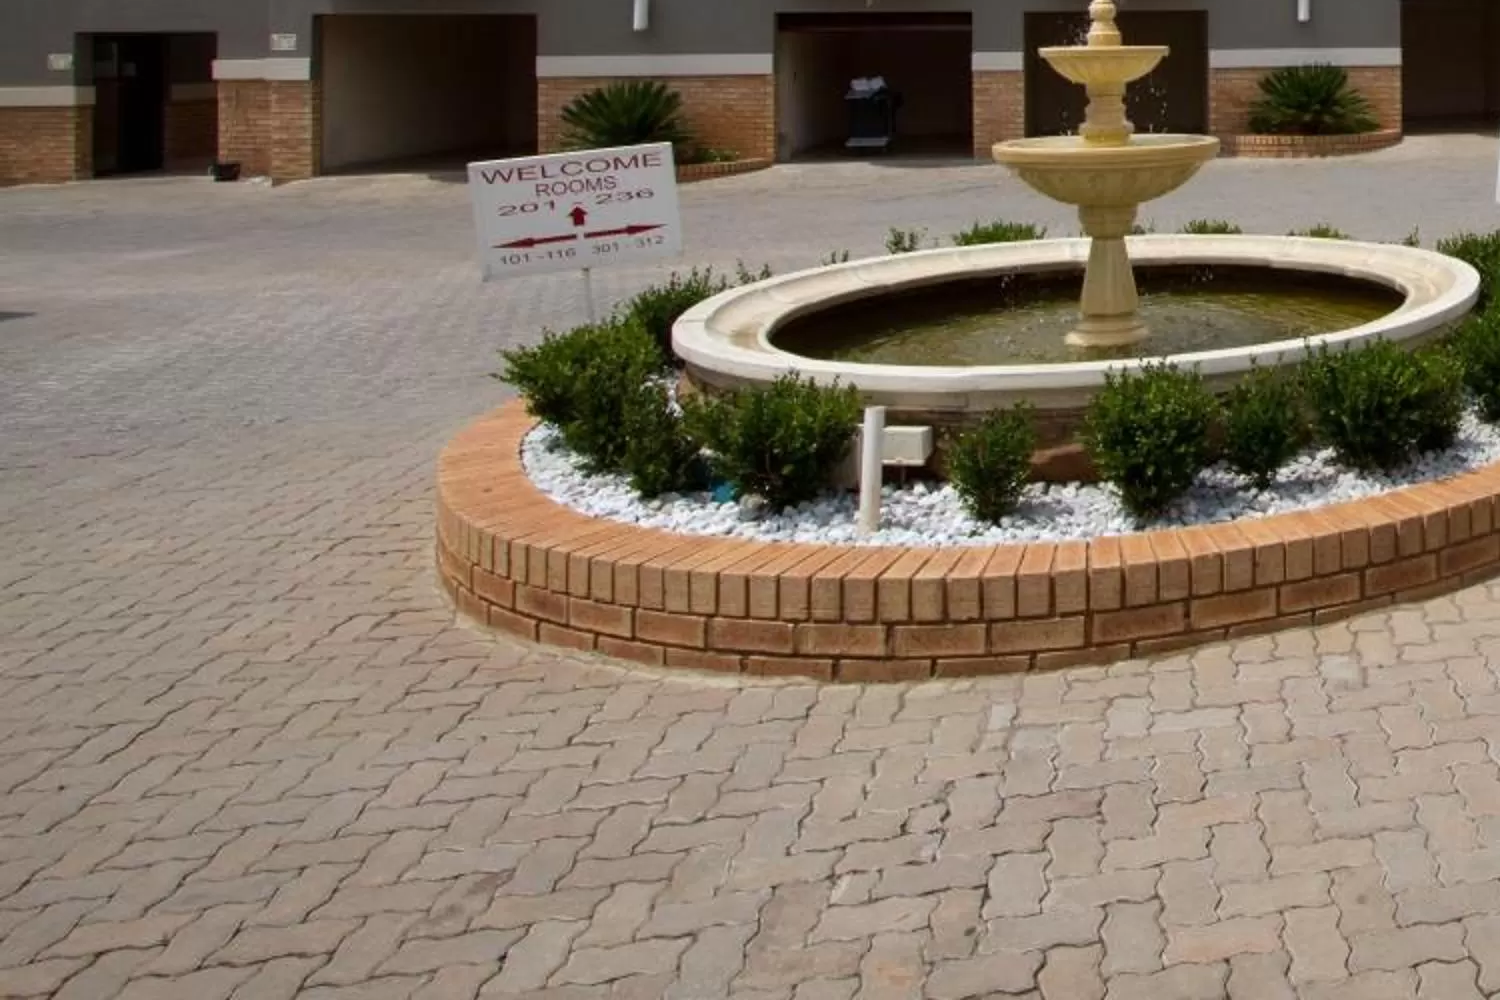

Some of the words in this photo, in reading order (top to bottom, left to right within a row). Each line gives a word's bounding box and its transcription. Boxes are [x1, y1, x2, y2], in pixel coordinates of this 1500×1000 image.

[481, 152, 662, 185] WELCOME
[535, 175, 617, 197] ROOMS
[498, 200, 556, 217] 201
[500, 253, 530, 266] 101
